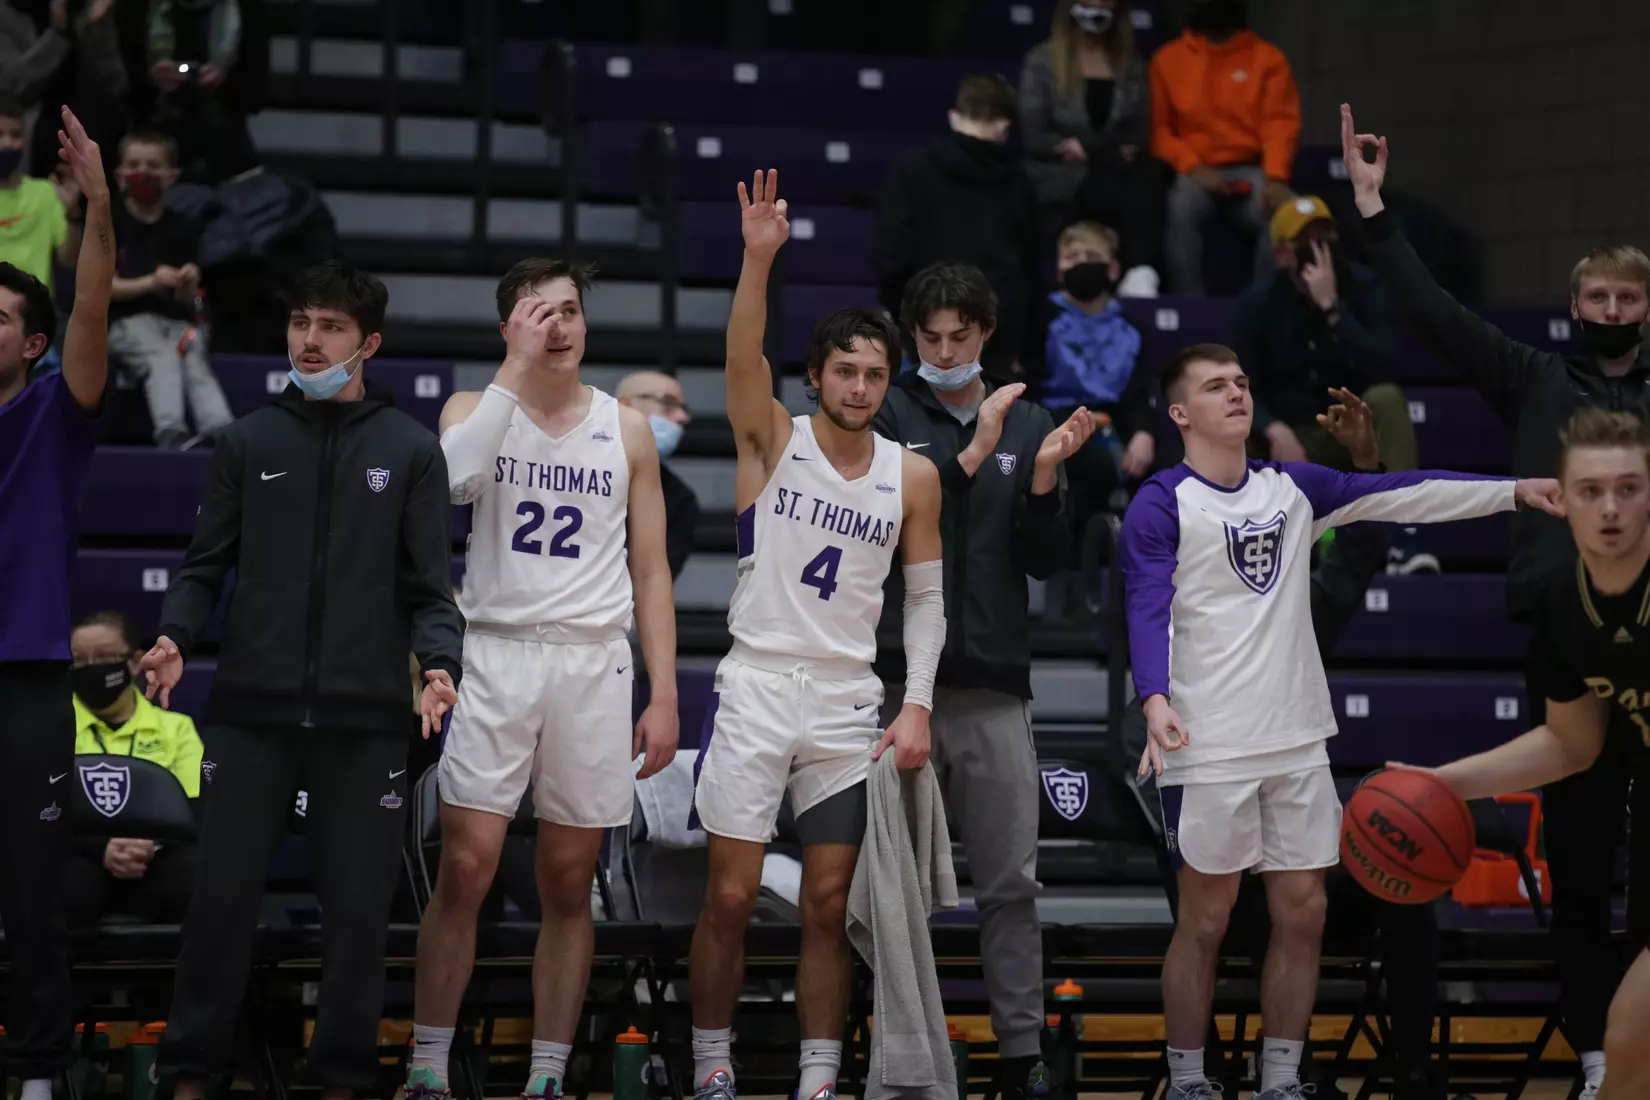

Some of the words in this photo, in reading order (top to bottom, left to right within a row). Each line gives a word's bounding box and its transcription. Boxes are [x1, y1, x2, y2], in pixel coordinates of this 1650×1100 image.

[495, 456, 519, 485] ST.
[527, 462, 612, 497] THOMAS
[511, 501, 583, 559] 22
[774, 487, 803, 521] ST.
[810, 498, 894, 547] THOMAS
[800, 545, 843, 601] 4
[1368, 808, 1424, 861] NCAA
